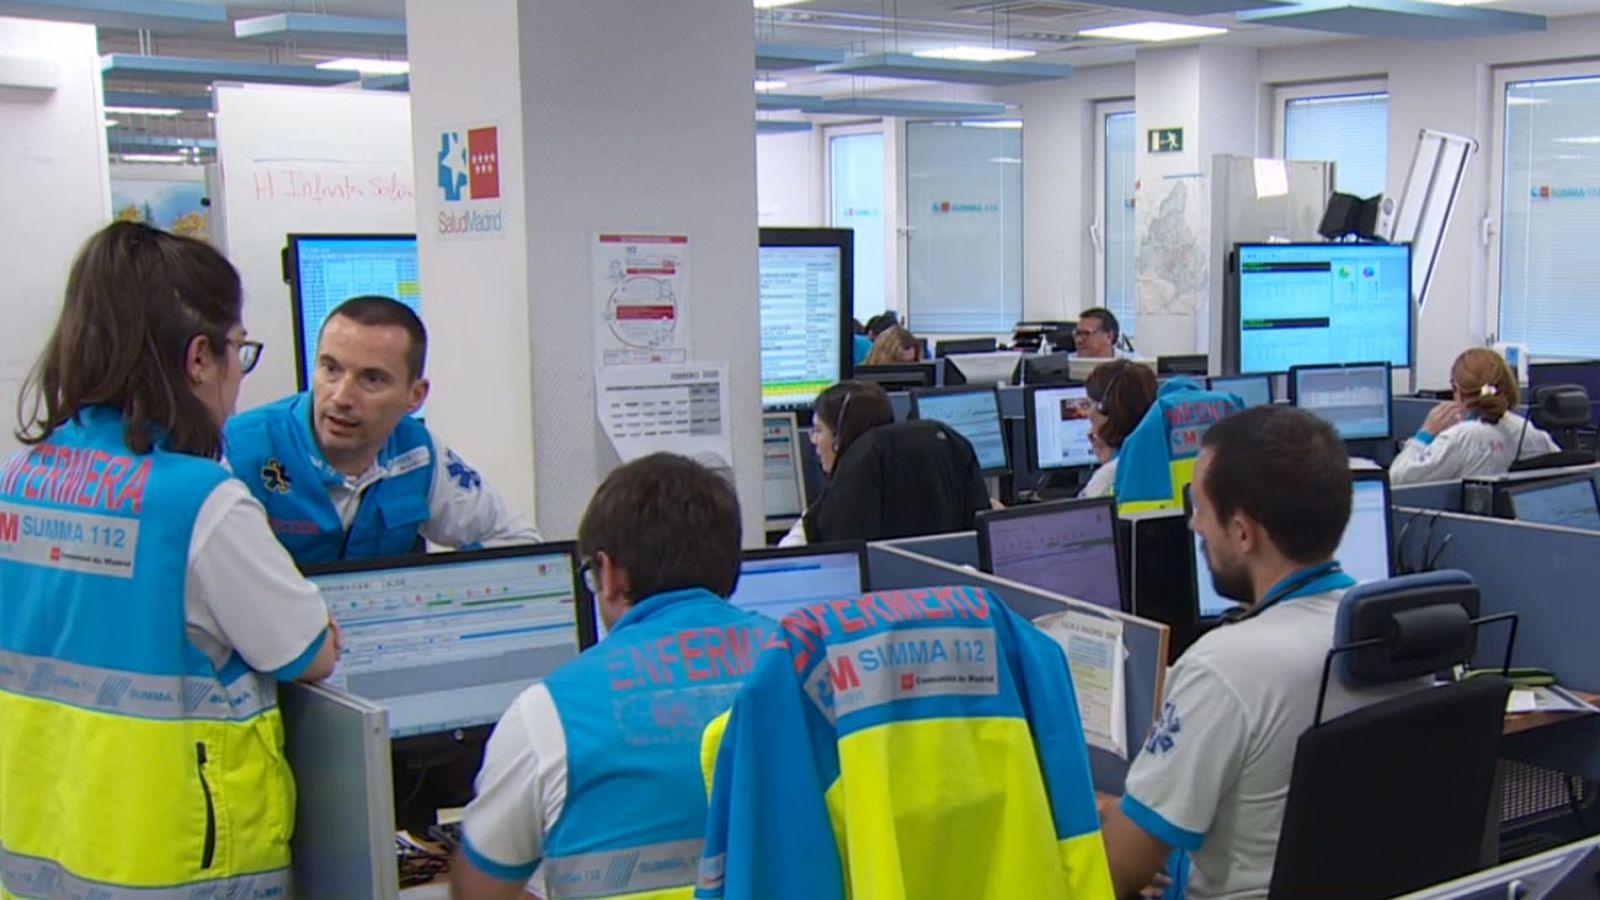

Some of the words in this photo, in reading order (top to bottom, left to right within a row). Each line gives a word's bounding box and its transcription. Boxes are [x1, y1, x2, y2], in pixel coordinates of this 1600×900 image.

[253, 170, 274, 200] H
[0, 444, 153, 513] NFERMERA
[22, 515, 85, 543] SUMMA
[91, 525, 127, 549] 112
[607, 624, 790, 691] ENFERM
[858, 639, 948, 672] SUMMA
[953, 639, 986, 663] 112
